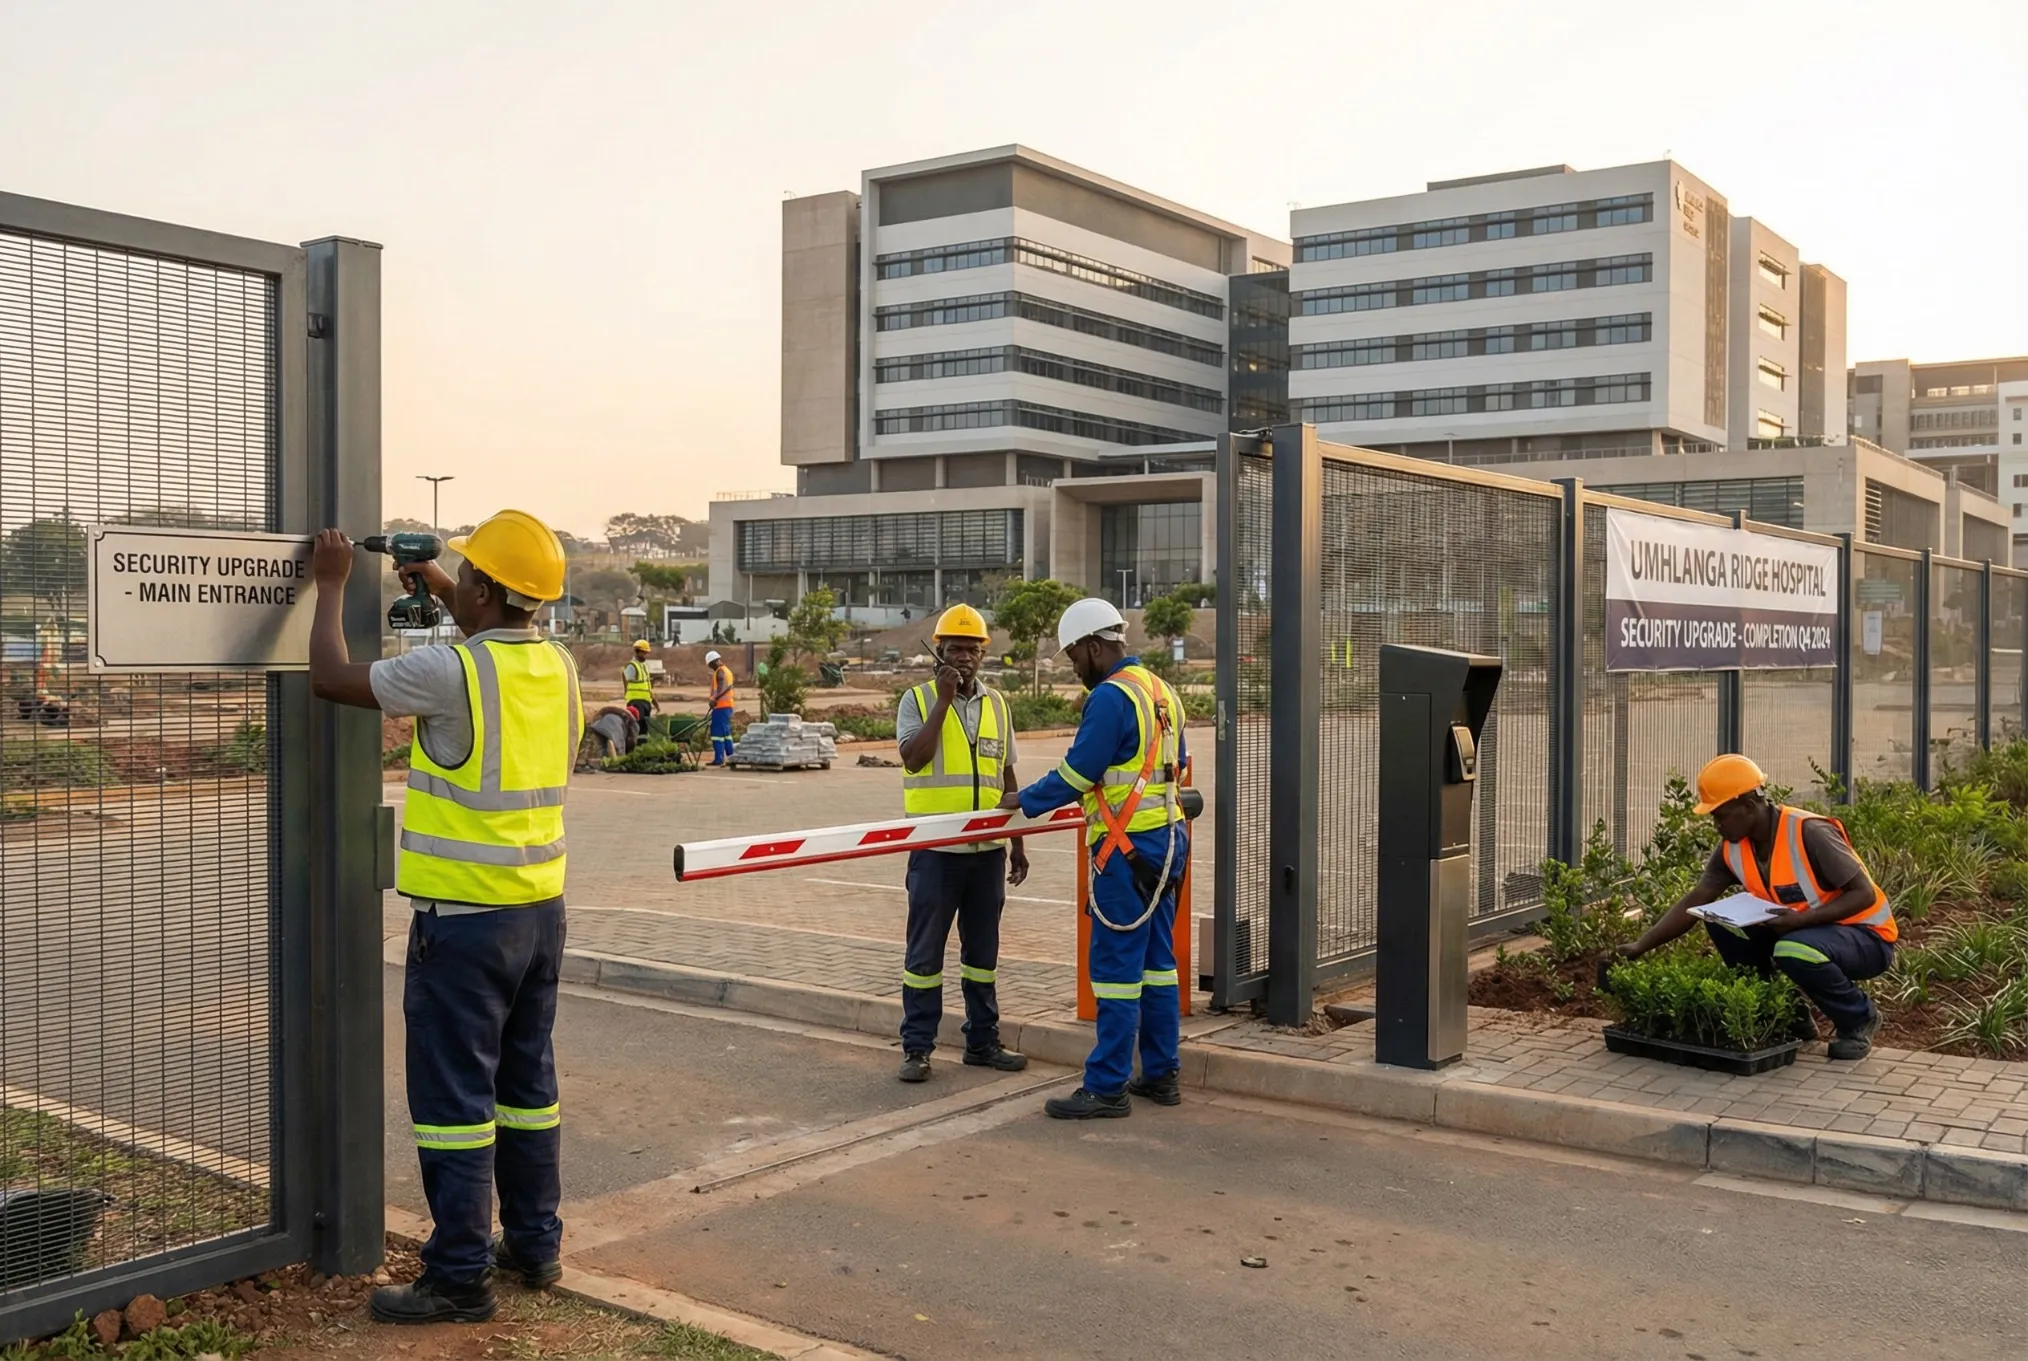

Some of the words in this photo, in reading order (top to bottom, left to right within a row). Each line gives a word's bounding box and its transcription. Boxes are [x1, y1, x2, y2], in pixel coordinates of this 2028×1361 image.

[113, 552, 211, 576] SECURITY
[217, 557, 305, 579] UPGRADE
[1630, 540, 1727, 588] UMHLANGA
[1731, 553, 1769, 592] RIDGE
[1772, 559, 1826, 597] HOSPITAL
[139, 582, 191, 603] MAIN
[199, 584, 295, 605] ENTRANCE
[1621, 617, 1681, 648] SECURITY
[1684, 620, 1737, 648] UPGRADE
[1743, 622, 1798, 649] COMPLETION
[1798, 624, 1811, 652] Q4
[1811, 626, 1831, 649] 2024
